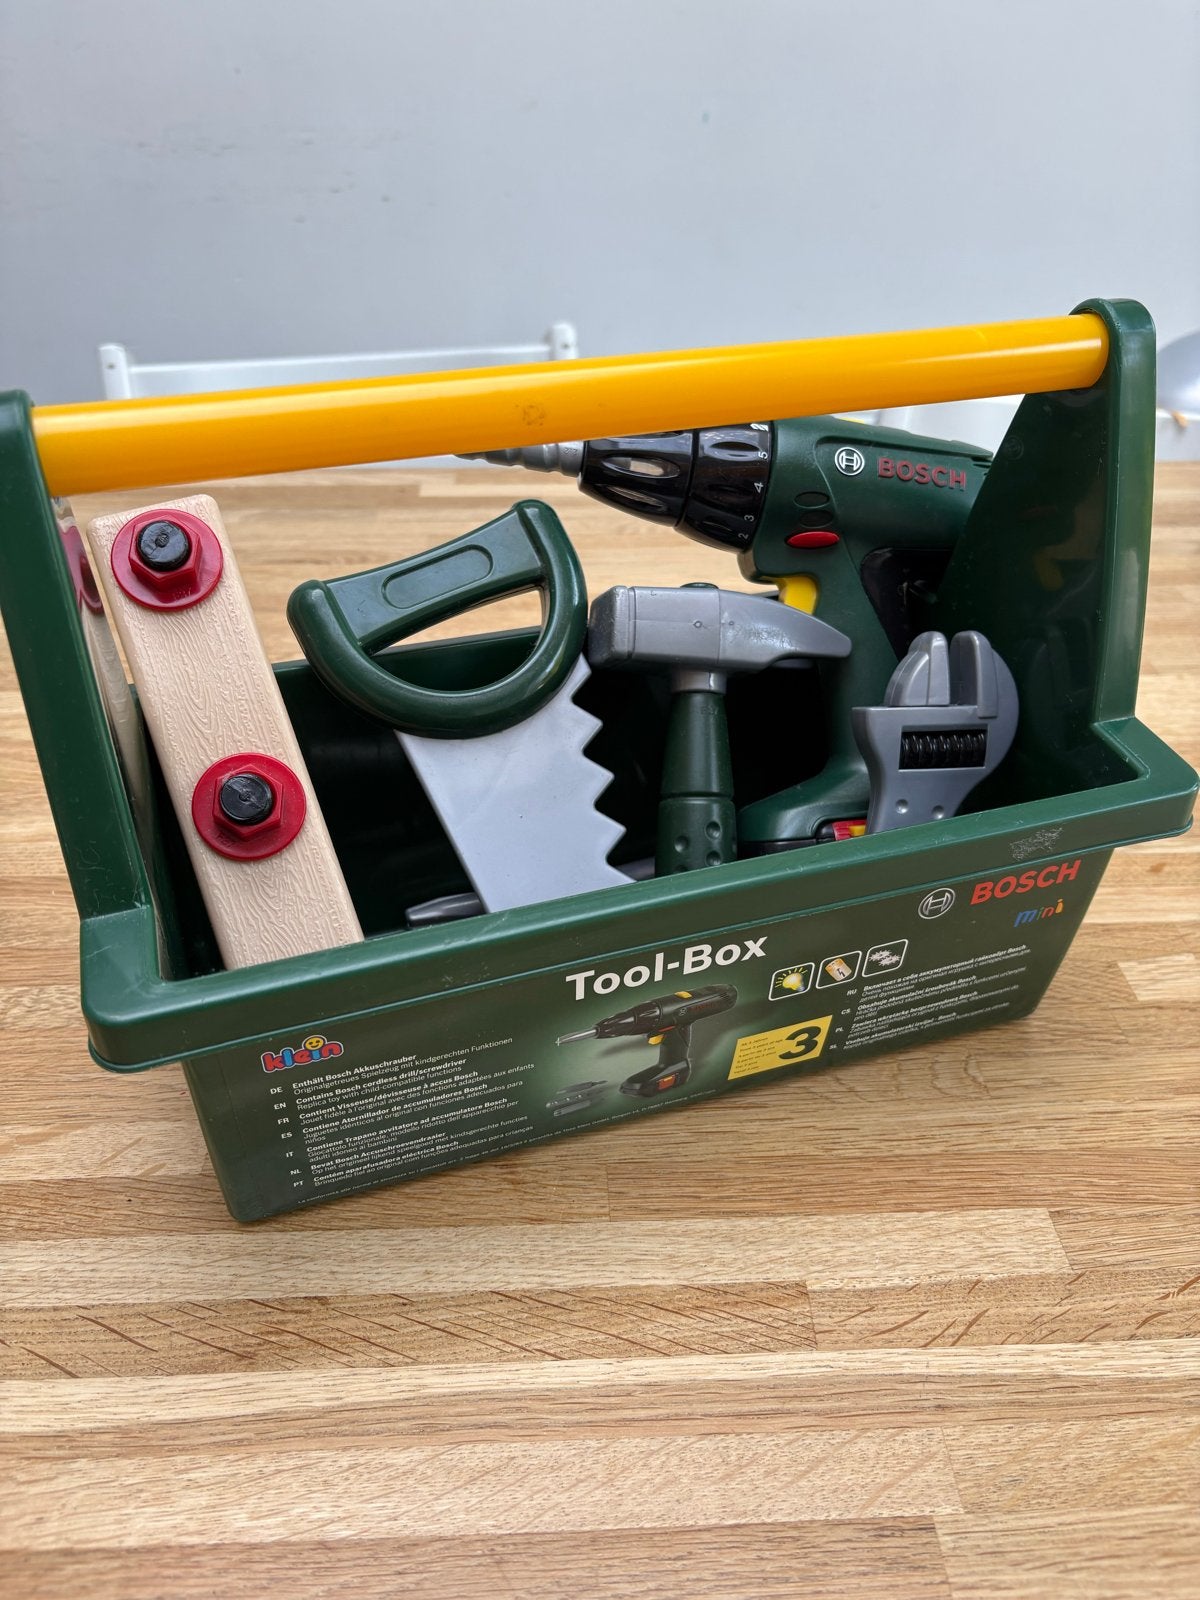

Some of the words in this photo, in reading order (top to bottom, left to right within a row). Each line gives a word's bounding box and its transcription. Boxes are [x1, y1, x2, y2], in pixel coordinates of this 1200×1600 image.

[758, 450, 768, 460] 5
[877, 457, 966, 490] BOSCH
[753, 481, 764, 493] 4
[970, 860, 1081, 905] BOSCH
[1014, 899, 1064, 927] mini
[566, 937, 767, 1000] Tool-Box
[261, 1036, 344, 1073] klein
[779, 1026, 821, 1059] 3
[292, 1077, 324, 1089] Enthält
[325, 1070, 351, 1081] Bosch
[352, 1054, 417, 1074] Akkuschrauber
[293, 1075, 359, 1096] Originalgetreues
[360, 1065, 399, 1079] Spielzeug
[414, 1048, 469, 1066] kindgerechten
[470, 1037, 513, 1052] Funktionen
[295, 1091, 334, 1104] Contains
[334, 1084, 360, 1095] Bosch
[362, 1075, 397, 1088] cordless
[398, 1058, 467, 1079] drill/screwdriver
[298, 1106, 335, 1119] Contient
[429, 1079, 452, 1087] accus
[453, 1071, 478, 1081] Bosch
[302, 1120, 340, 1133] Contiene
[340, 1108, 390, 1124] Atornillador
[463, 1084, 488, 1093] Bosch
